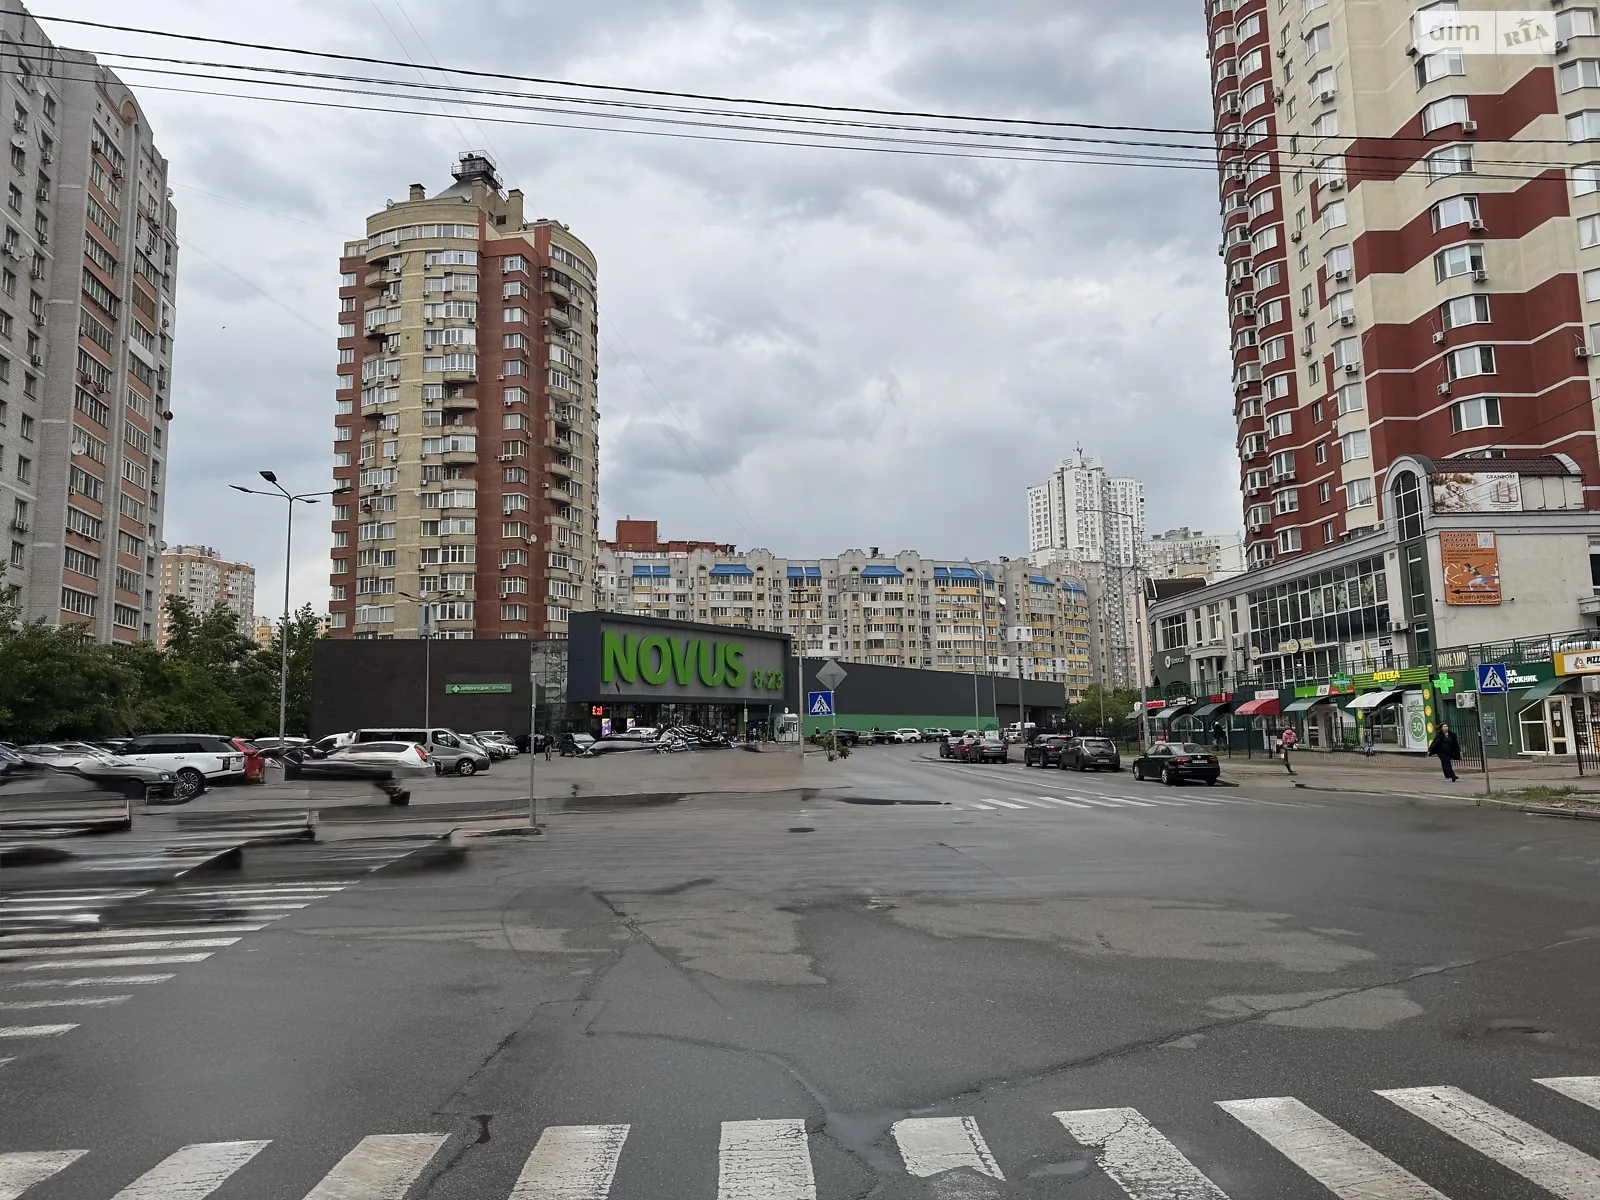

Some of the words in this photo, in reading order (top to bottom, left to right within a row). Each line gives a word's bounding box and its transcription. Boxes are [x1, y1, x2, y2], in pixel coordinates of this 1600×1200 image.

[601, 630, 746, 688] NOVUS
[1373, 670, 1401, 681] АПТЕКА
[1506, 674, 1539, 684] ОРОЖНИК
